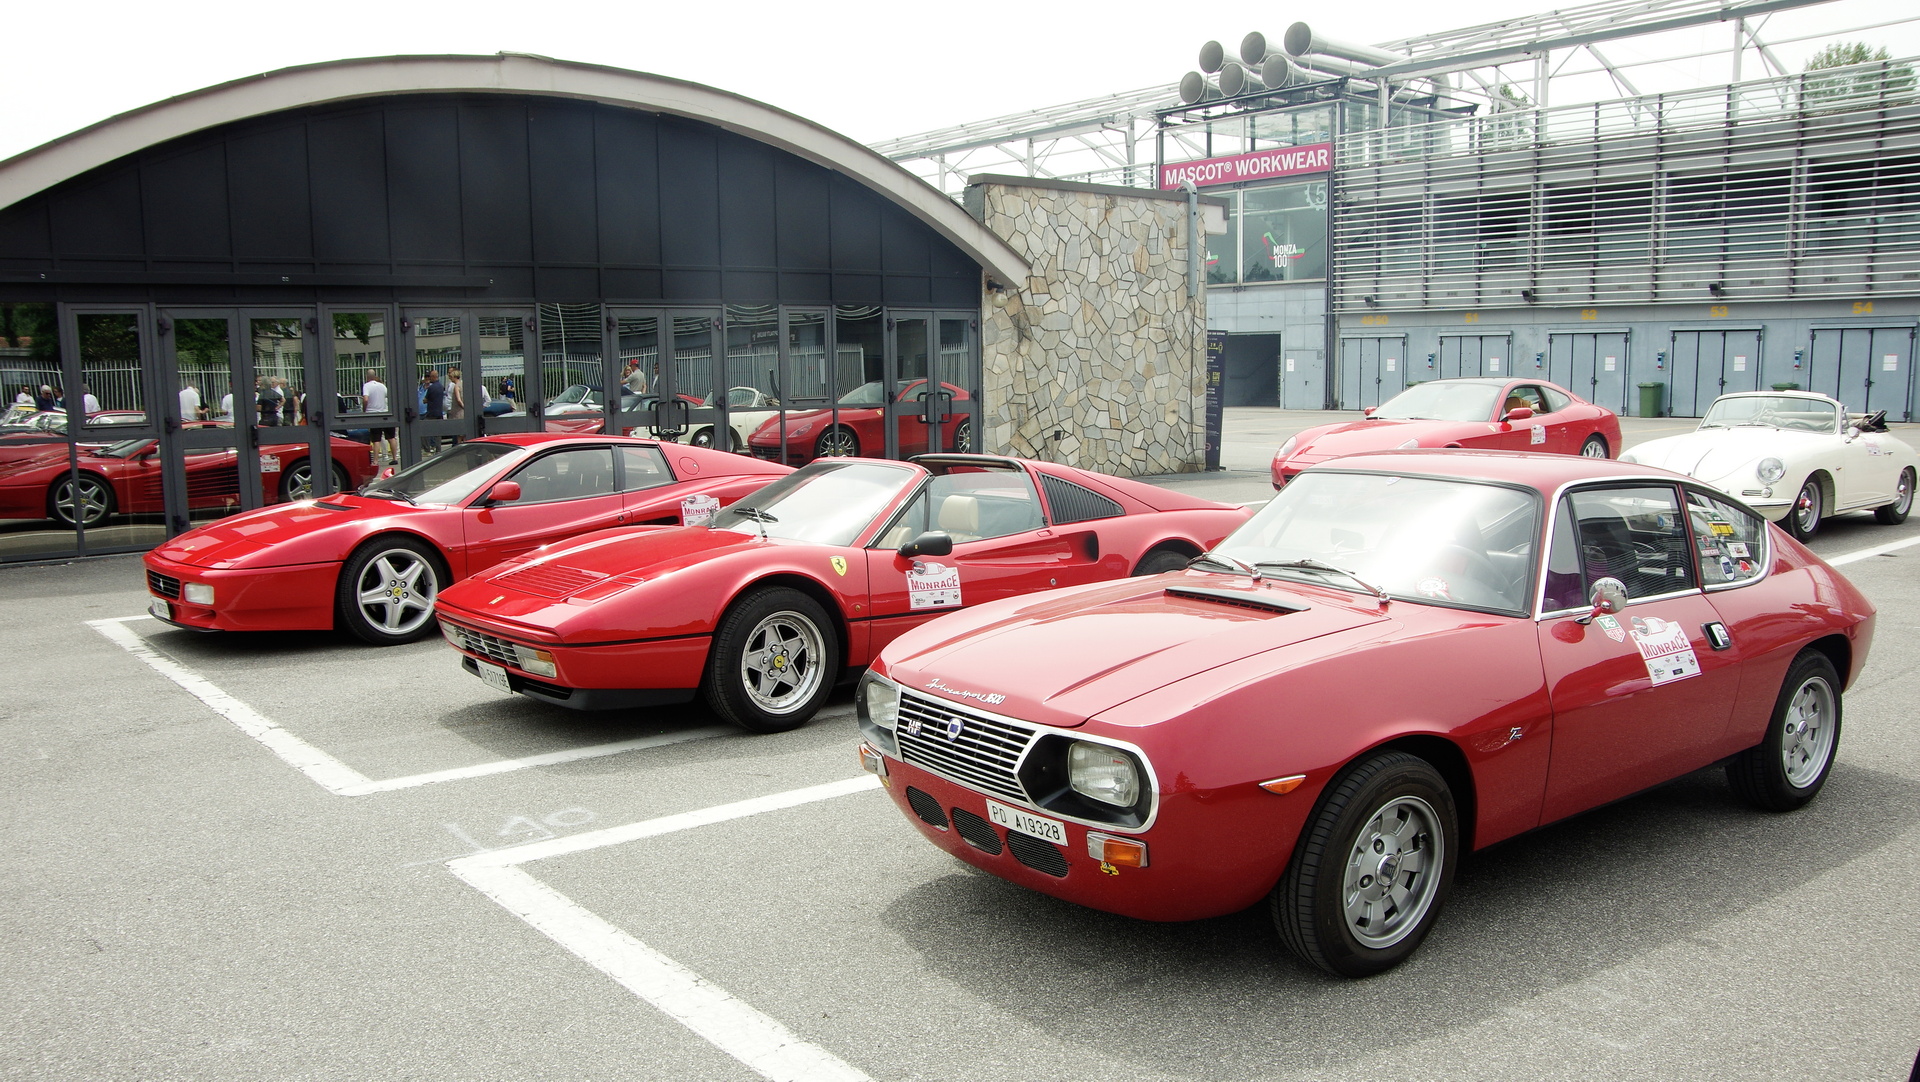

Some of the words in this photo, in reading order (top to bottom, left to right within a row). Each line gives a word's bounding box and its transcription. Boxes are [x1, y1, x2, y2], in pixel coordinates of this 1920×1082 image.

[1235, 149, 1328, 176] WORKWEAR
[1273, 244, 1297, 256] MONZA
[1273, 255, 1288, 268] 100
[1710, 306, 1728, 317] 53
[1852, 302, 1873, 314] 54
[1465, 313, 1479, 323] 51
[1581, 310, 1597, 321] 52
[910, 574, 958, 591] MONRACE
[1640, 631, 1689, 658] MONRACE
[991, 805, 1007, 823] PD
[1015, 814, 1060, 840] A19328
